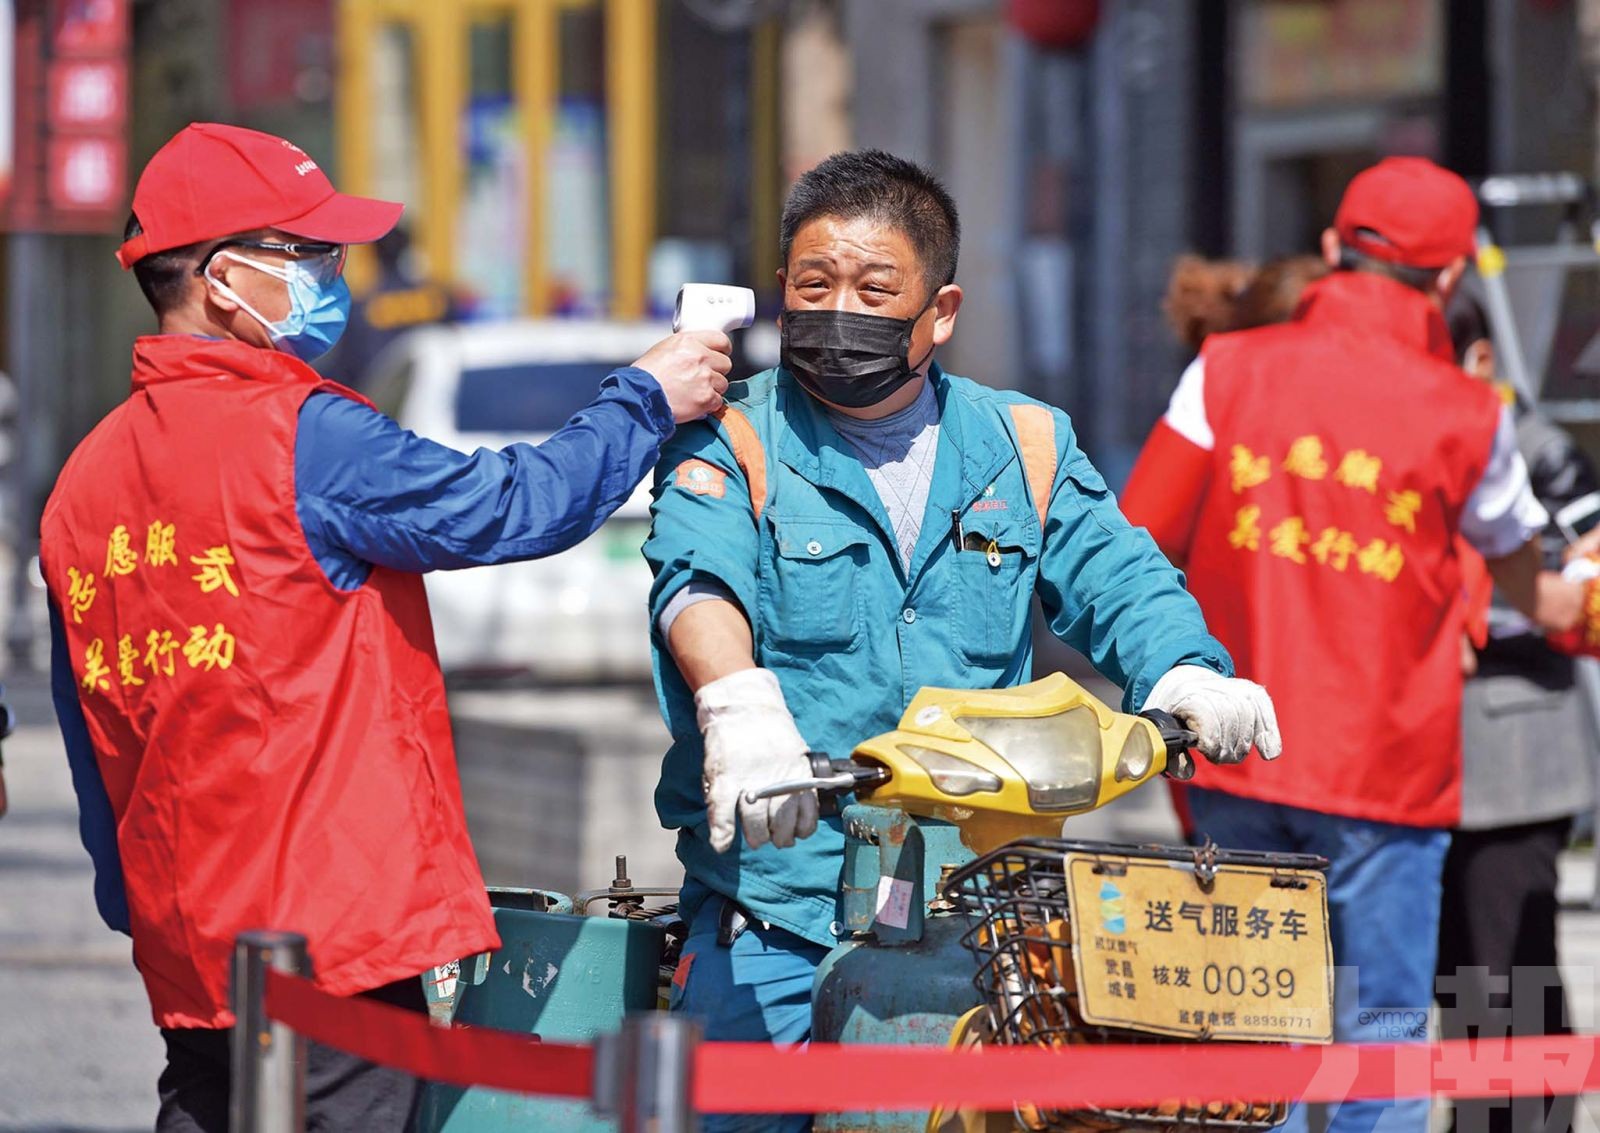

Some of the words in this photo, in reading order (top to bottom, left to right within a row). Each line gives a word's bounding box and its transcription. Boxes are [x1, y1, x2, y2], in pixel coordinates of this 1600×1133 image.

[1145, 901, 1308, 941] 送气服务车
[1153, 965, 1192, 988] 核发
[1203, 963, 1296, 998] 0039
[1178, 1009, 1236, 1026] 监督电话
[1243, 1015, 1312, 1029] 88936771
